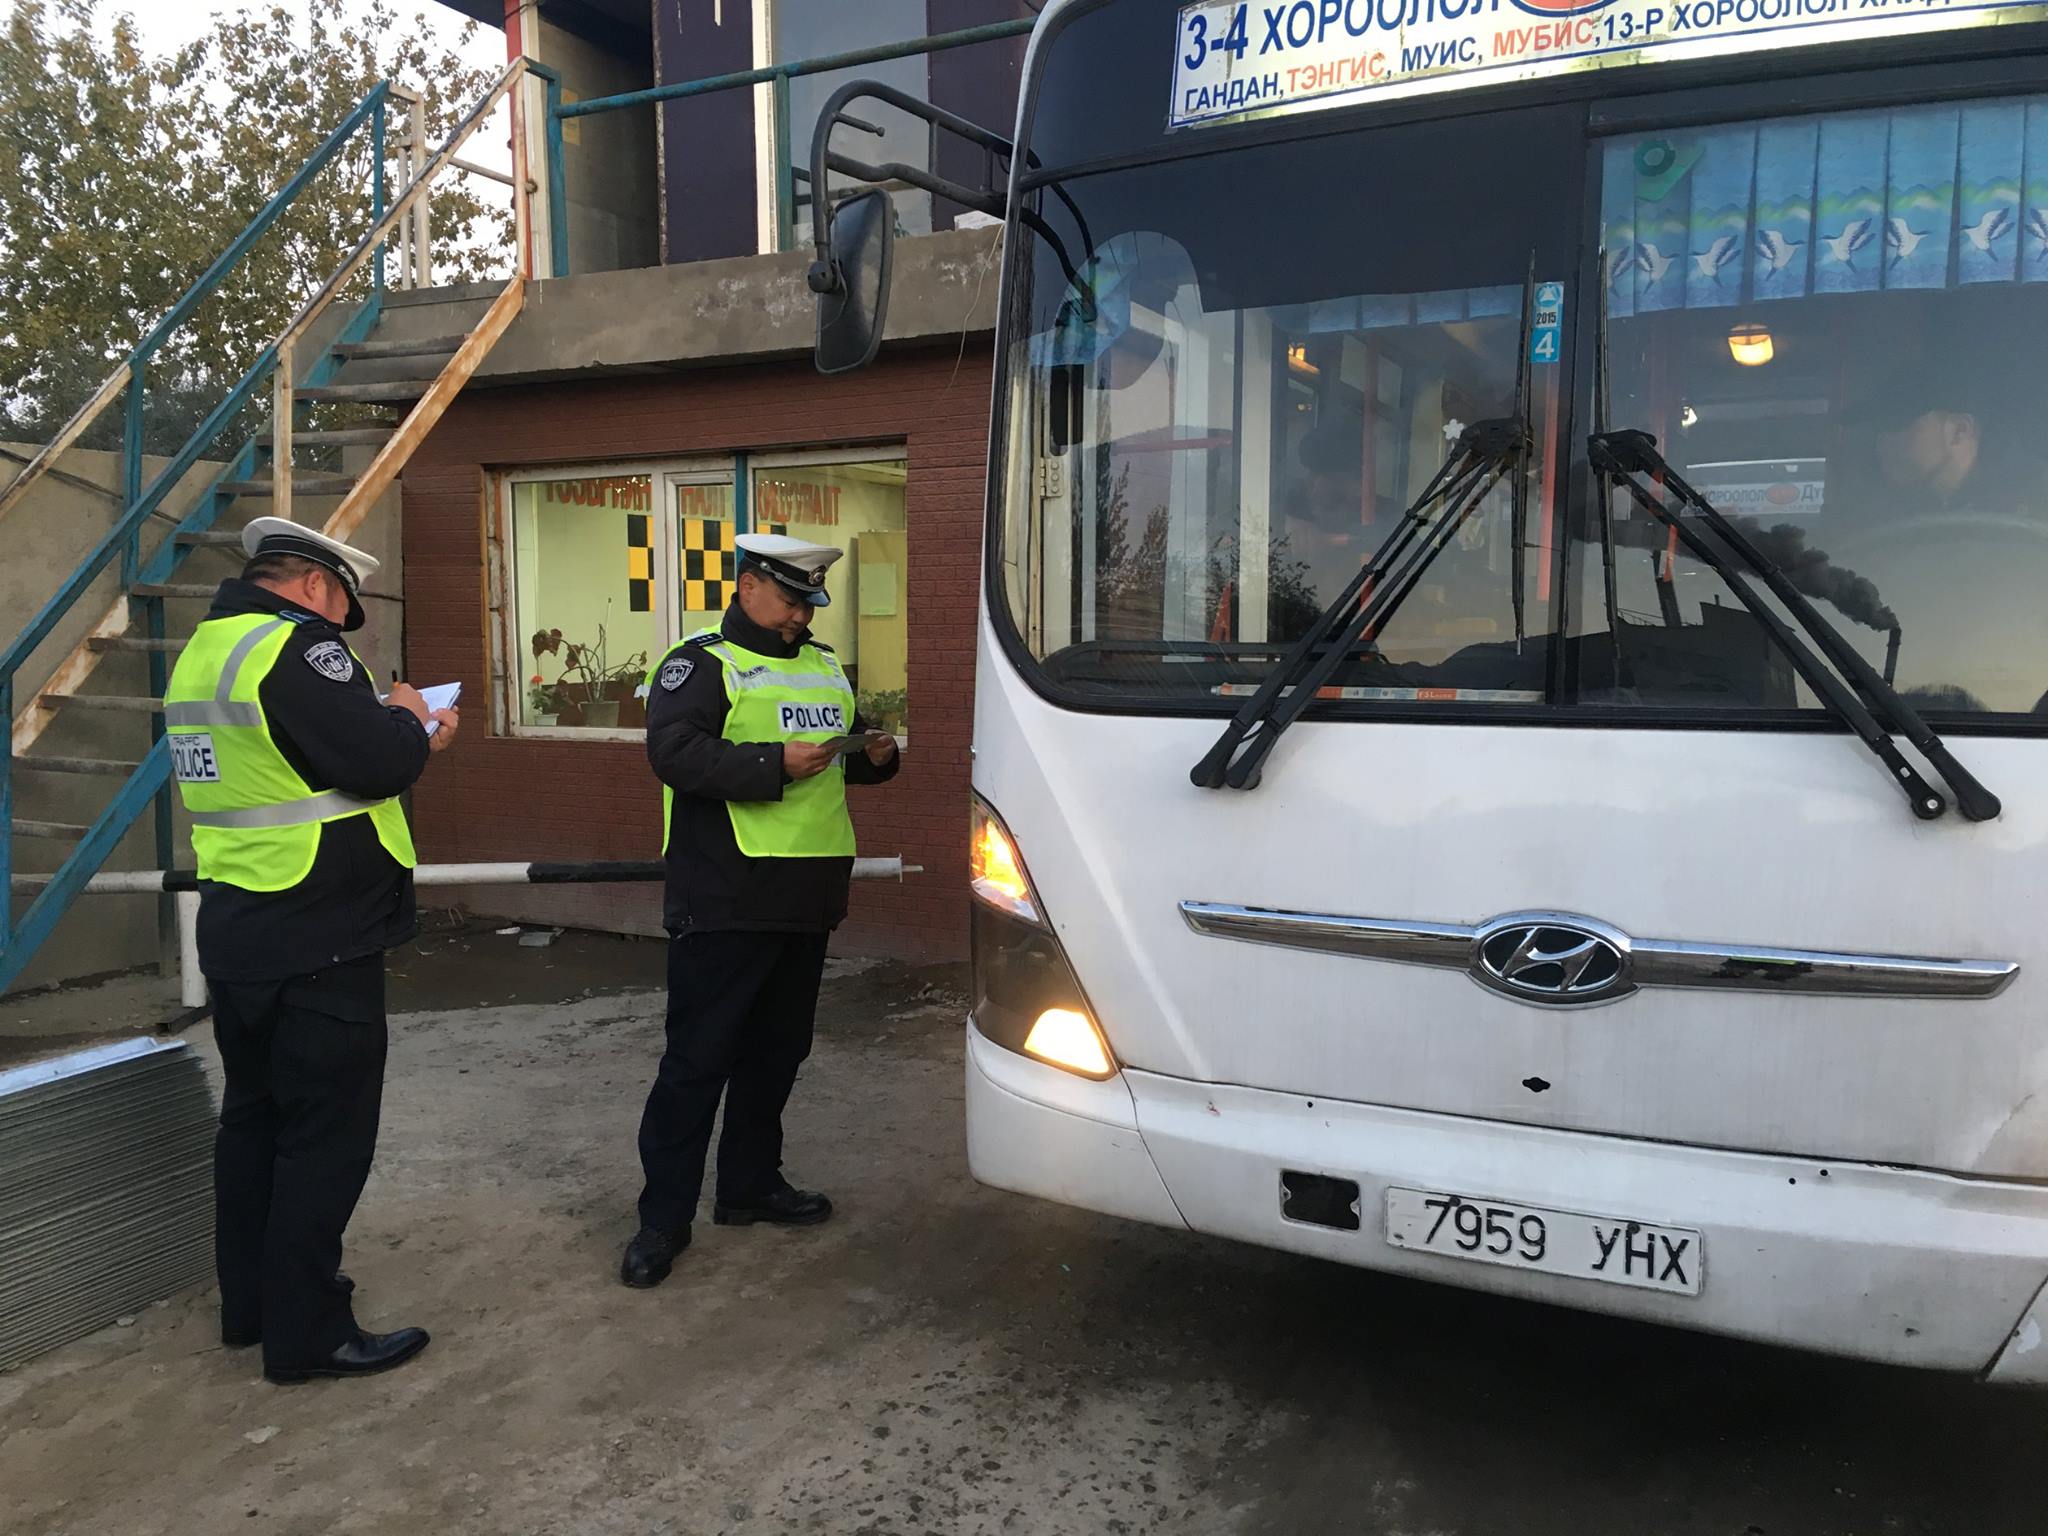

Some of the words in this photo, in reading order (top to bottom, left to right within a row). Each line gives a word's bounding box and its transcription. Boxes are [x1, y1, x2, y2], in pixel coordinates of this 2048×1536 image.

[1184, 4, 1249, 71] 3-4
[1259, 0, 1499, 55] ХОРООЛ
[1184, 72, 1285, 112] ГАНДАН,
[1287, 53, 1392, 93] ТЭНГИС,
[1401, 37, 1483, 73] МУИС,
[1536, 312, 1557, 325] 2015
[1535, 331, 1555, 358] 4
[781, 707, 843, 729] POLICE
[1425, 1199, 1546, 1261] 7959
[1592, 1225, 1690, 1286] УНХ
